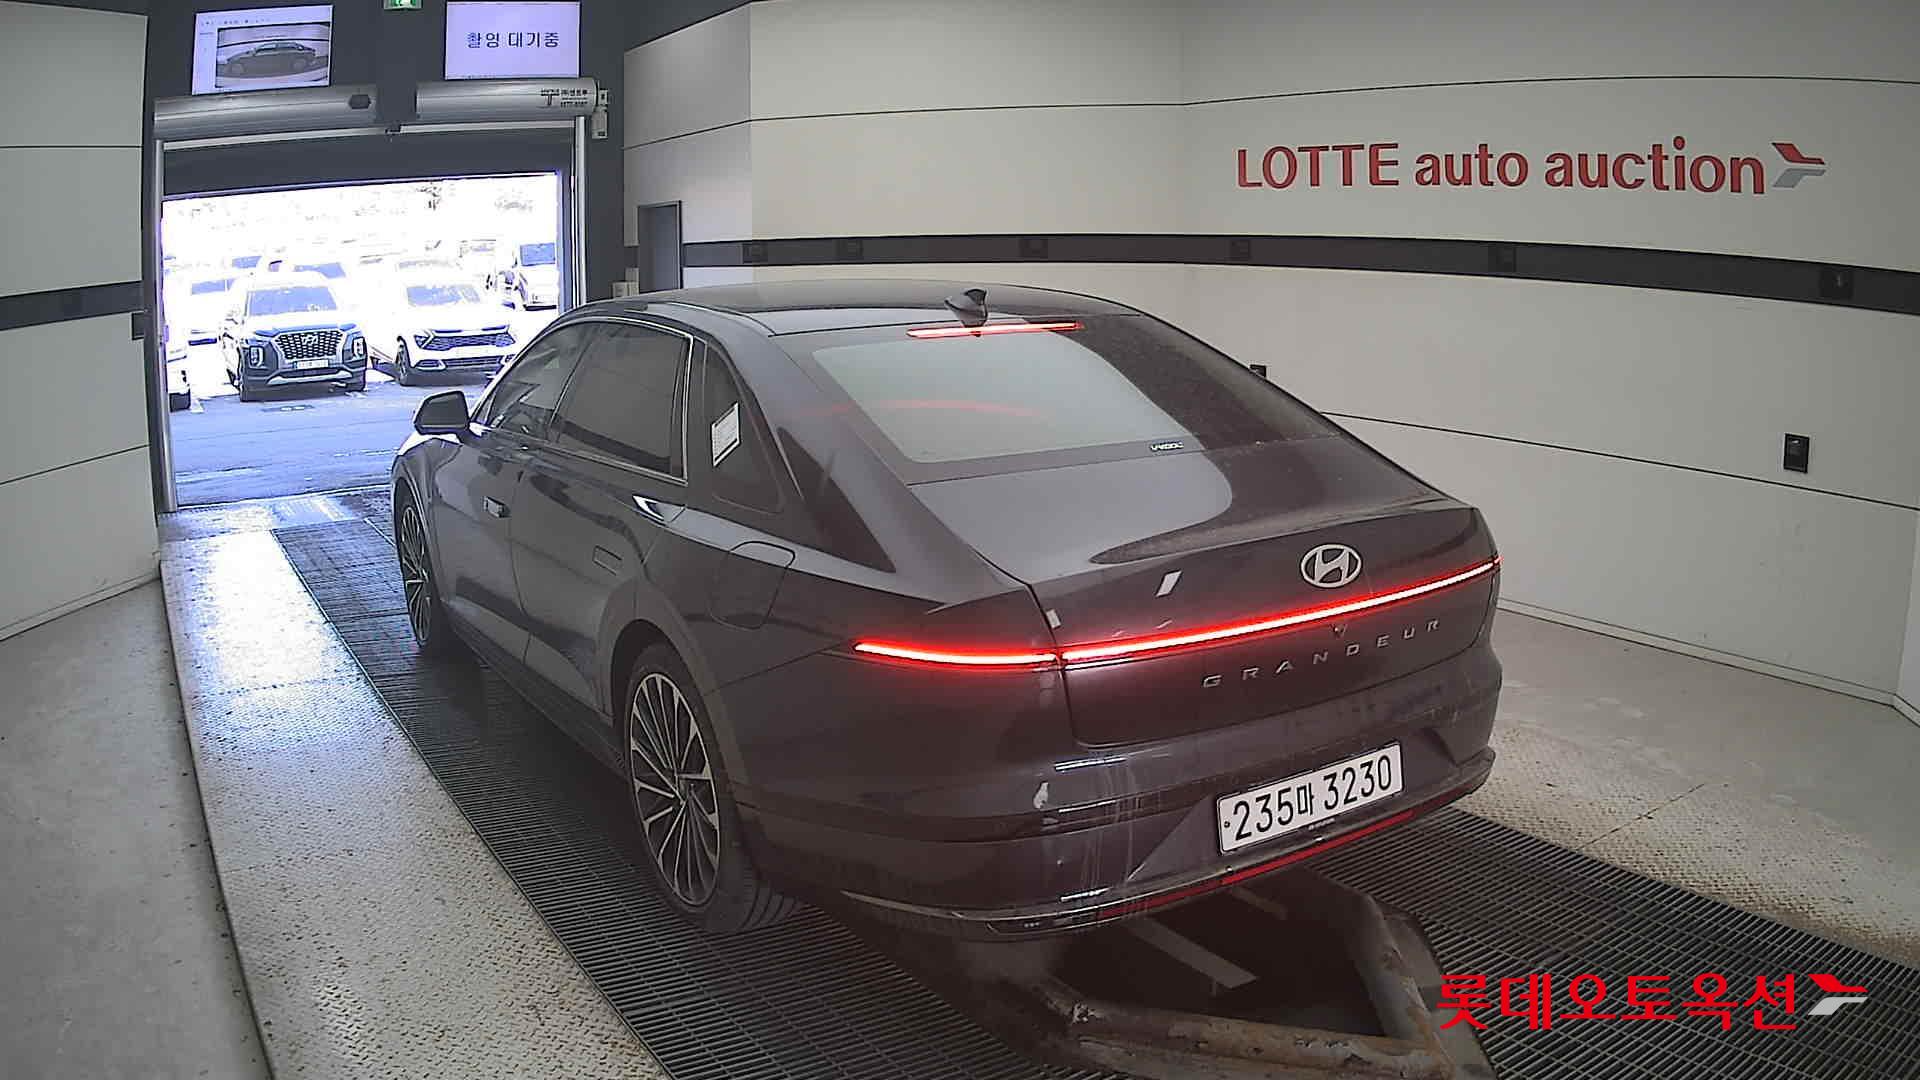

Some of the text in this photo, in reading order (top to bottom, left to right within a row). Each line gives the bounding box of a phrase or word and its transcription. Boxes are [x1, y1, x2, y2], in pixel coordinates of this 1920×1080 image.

[508, 31, 560, 49] 대기중
[1237, 135, 1765, 195] LOTTE auto auction
[1202, 618, 1441, 688] GRANDEUR
[1233, 755, 1392, 841] 235마 3230
